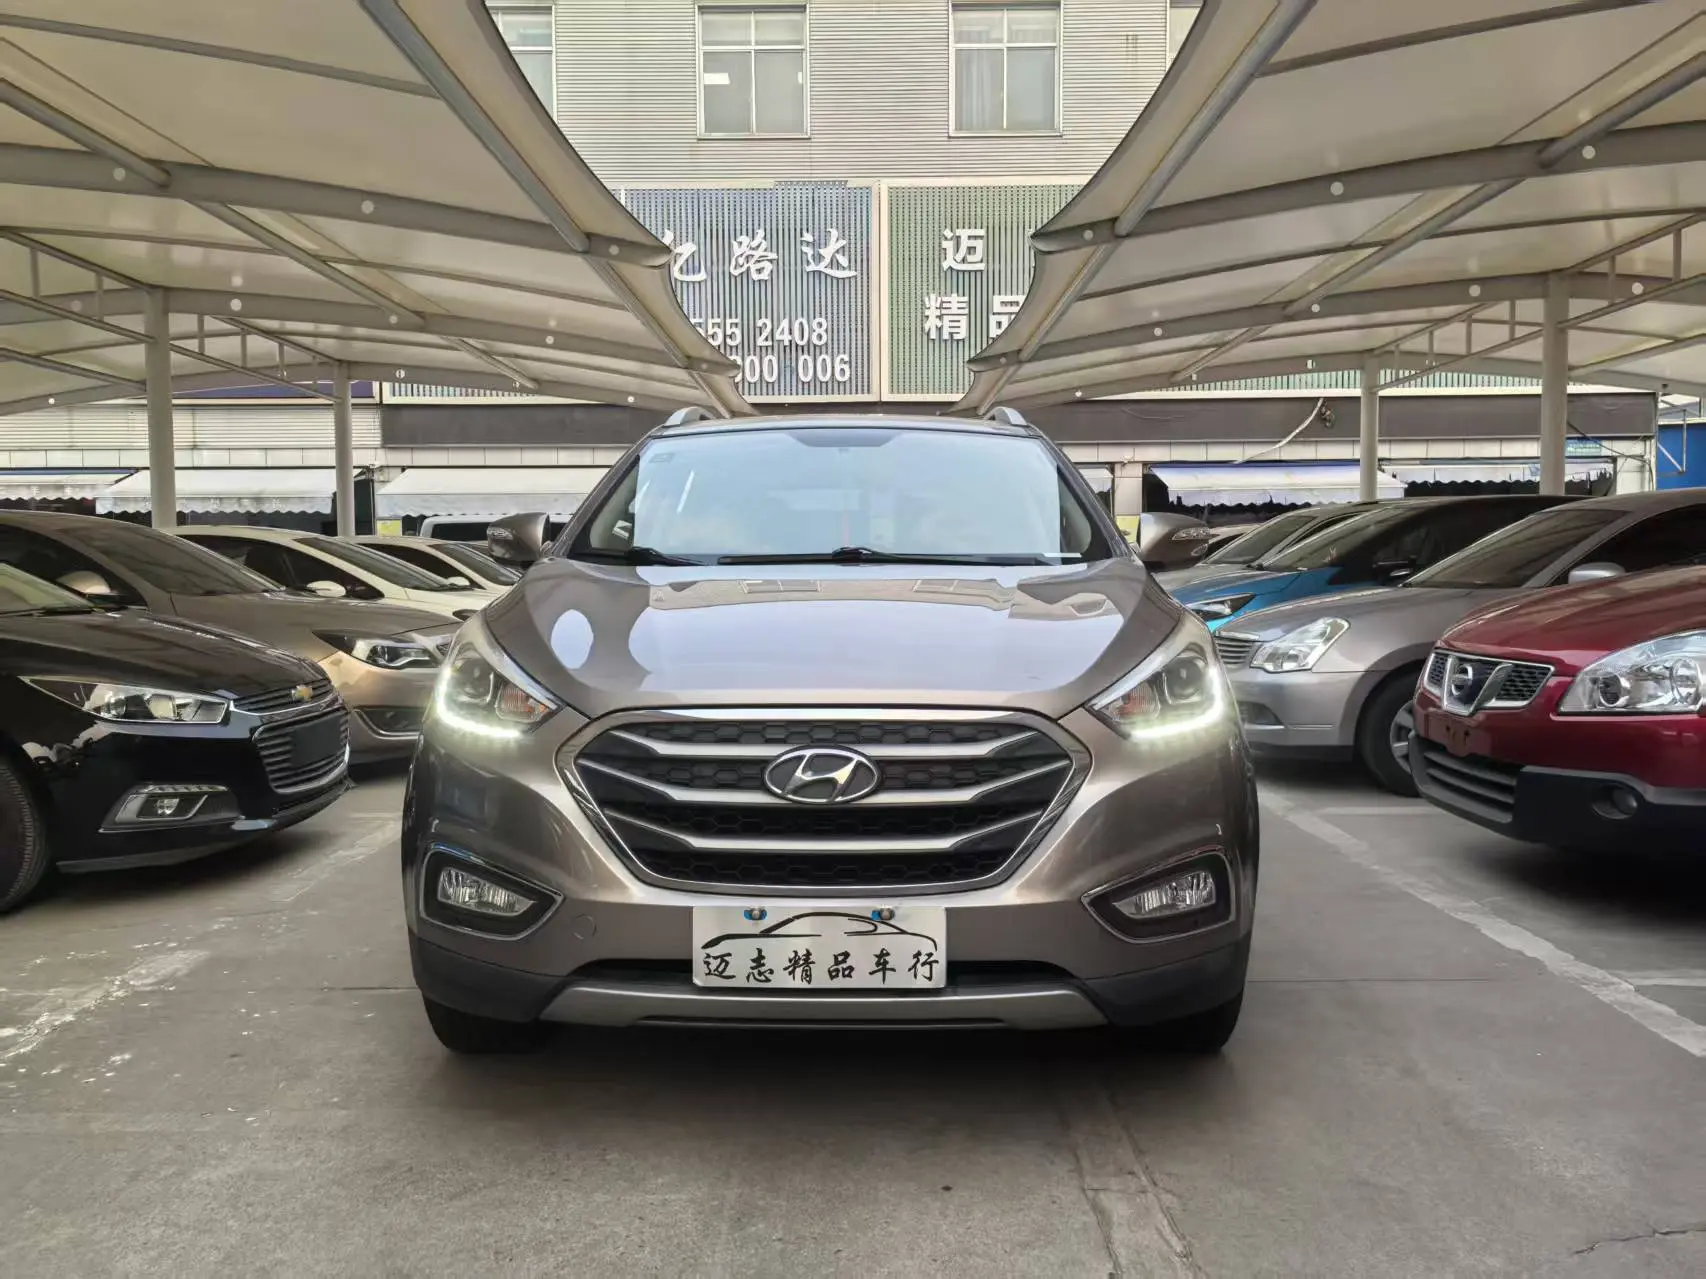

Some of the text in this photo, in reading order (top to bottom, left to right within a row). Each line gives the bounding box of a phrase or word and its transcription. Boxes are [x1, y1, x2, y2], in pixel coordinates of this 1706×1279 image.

[757, 317, 828, 347] 2408
[798, 354, 851, 383] 006
[702, 948, 940, 985] 迈志精品车行
